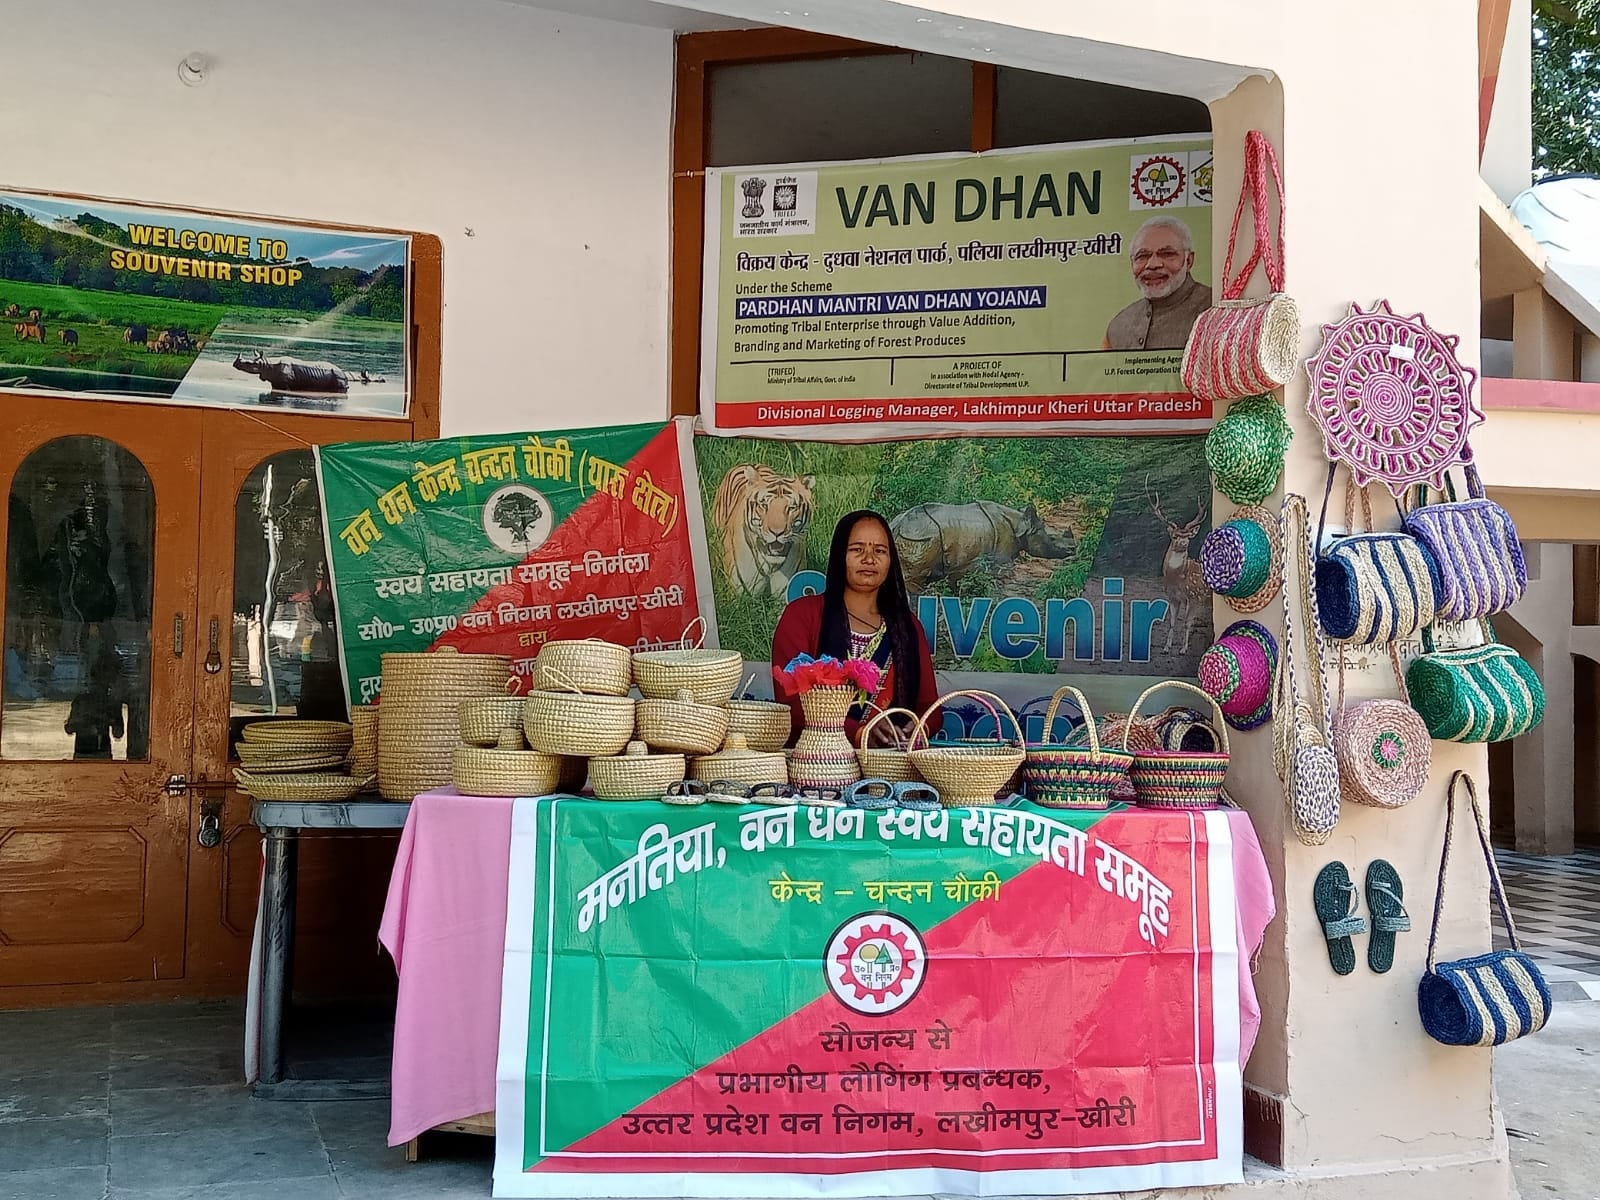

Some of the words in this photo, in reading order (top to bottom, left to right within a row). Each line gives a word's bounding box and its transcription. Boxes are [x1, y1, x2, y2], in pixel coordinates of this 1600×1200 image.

[835, 181, 936, 229] VAN
[954, 170, 1102, 222] DHAN
[128, 224, 250, 257] WELCOME
[257, 239, 288, 260] TO
[736, 251, 776, 272] विक्रय
[779, 250, 809, 271] केन्द्र
[823, 251, 860, 274] दुधवा
[864, 245, 912, 266] नेशनल
[916, 242, 953, 264] पार्क,
[957, 240, 1003, 262] पलिया
[1008, 233, 1122, 263] लखीमपुर-खीरी
[110, 250, 232, 281] SOUVENIR
[239, 263, 303, 287] SHOP
[735, 282, 768, 295] Under
[770, 281, 788, 293] the
[790, 281, 833, 293] Scheme
[739, 299, 813, 316] PARDHAN
[818, 296, 881, 314] MANTRI
[885, 294, 919, 311] VAN
[924, 291, 972, 309] DHAN
[976, 289, 1042, 307] YOJANA
[734, 321, 789, 336] Promoting
[791, 320, 822, 332] Tribal
[824, 318, 880, 334] Enterprise
[882, 317, 926, 331] through
[929, 315, 960, 328] Value
[963, 314, 1016, 327] Addition,
[734, 340, 780, 353] Branding
[782, 339, 803, 351] and
[806, 337, 861, 352] Marketing
[863, 336, 875, 348] of
[877, 335, 912, 347] Forest
[914, 334, 966, 347] Produces
[767, 366, 796, 377] (TRIFED)
[952, 362, 959, 370] A
[959, 361, 991, 370] PROJECT
[991, 361, 1002, 369] OF
[1104, 368, 1116, 376] U.P.
[1116, 367, 1136, 375] Forest
[1136, 366, 1172, 376] Corporation
[1124, 356, 1166, 366] Implementing
[767, 376, 786, 385] Ministry
[924, 382, 955, 390] Directorate
[955, 381, 962, 389] of
[962, 381, 979, 389] Tribal
[980, 381, 1018, 390] Development
[1018, 380, 1030, 388] U.P.
[999, 371, 1020, 379] Agency
[757, 405, 825, 420] Divisional
[829, 404, 884, 420] Logging
[888, 403, 959, 418] Manager,
[963, 401, 1044, 418] Lakhimpur
[1048, 400, 1088, 415] Kheri
[1093, 400, 1134, 414] Uttar
[1138, 398, 1202, 413] Pradesh
[339, 508, 384, 556] वन
[377, 481, 417, 526] धन
[412, 457, 463, 503] केन्द्र
[461, 445, 518, 485] चन्दन
[522, 435, 574, 483] चौकी
[373, 567, 425, 599] स्वयं
[427, 566, 514, 593] सहायता
[518, 547, 650, 591] समूह-निर्मला
[461, 610, 493, 629] वन
[496, 602, 552, 626] निगम
[786, 570, 1169, 663] venir
[517, 630, 548, 648] द्वारा
[576, 821, 728, 934] मनतिया,
[738, 804, 799, 853] वन
[807, 806, 865, 842] धन
[959, 806, 1089, 878] सहायता
[1092, 837, 1174, 947] समूह
[768, 870, 824, 905] केन्द्र
[863, 880, 933, 905] चन्दन
[941, 871, 1002, 903] चौकी
[861, 974, 873, 982] वन
[818, 1021, 917, 1052] सौजन्य
[925, 1019, 953, 1050] से
[715, 1064, 830, 1095] प्रभागीय
[838, 1062, 932, 1093] लौगिंग
[940, 1068, 1051, 1095] प्रबन्धक,
[621, 1112, 695, 1136] उत्तर
[702, 1104, 769, 1137] प्रदेश
[779, 1112, 823, 1135] वन
[832, 1103, 924, 1138] निगम,
[935, 1095, 1137, 1140] लखीमपुर-खीरी
